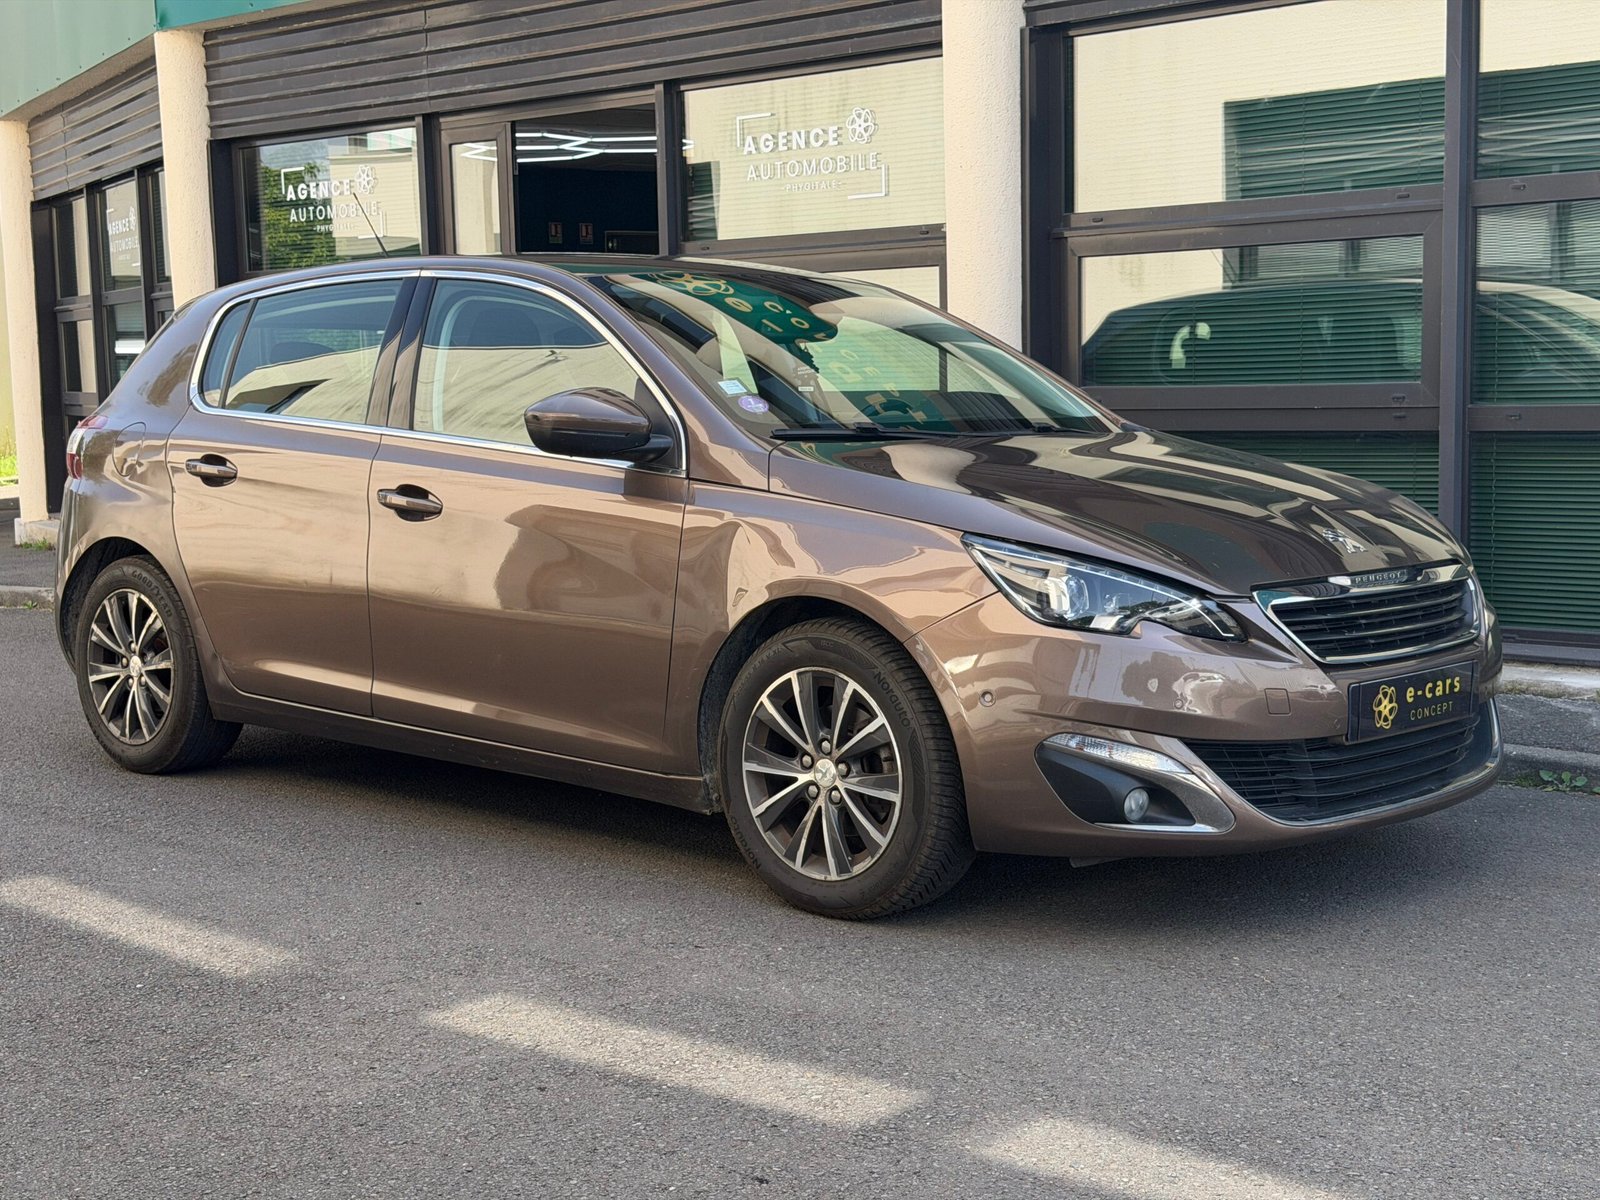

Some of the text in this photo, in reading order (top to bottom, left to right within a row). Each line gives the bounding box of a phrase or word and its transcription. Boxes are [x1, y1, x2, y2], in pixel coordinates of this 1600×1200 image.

[743, 126, 839, 155] AGENCE
[746, 152, 878, 181] AUTOMOBILE
[286, 179, 351, 201] AGENCE
[1355, 571, 1402, 584] PEUGEOT
[1406, 676, 1461, 702] e-cars
[1410, 701, 1454, 720] CONCEPT
